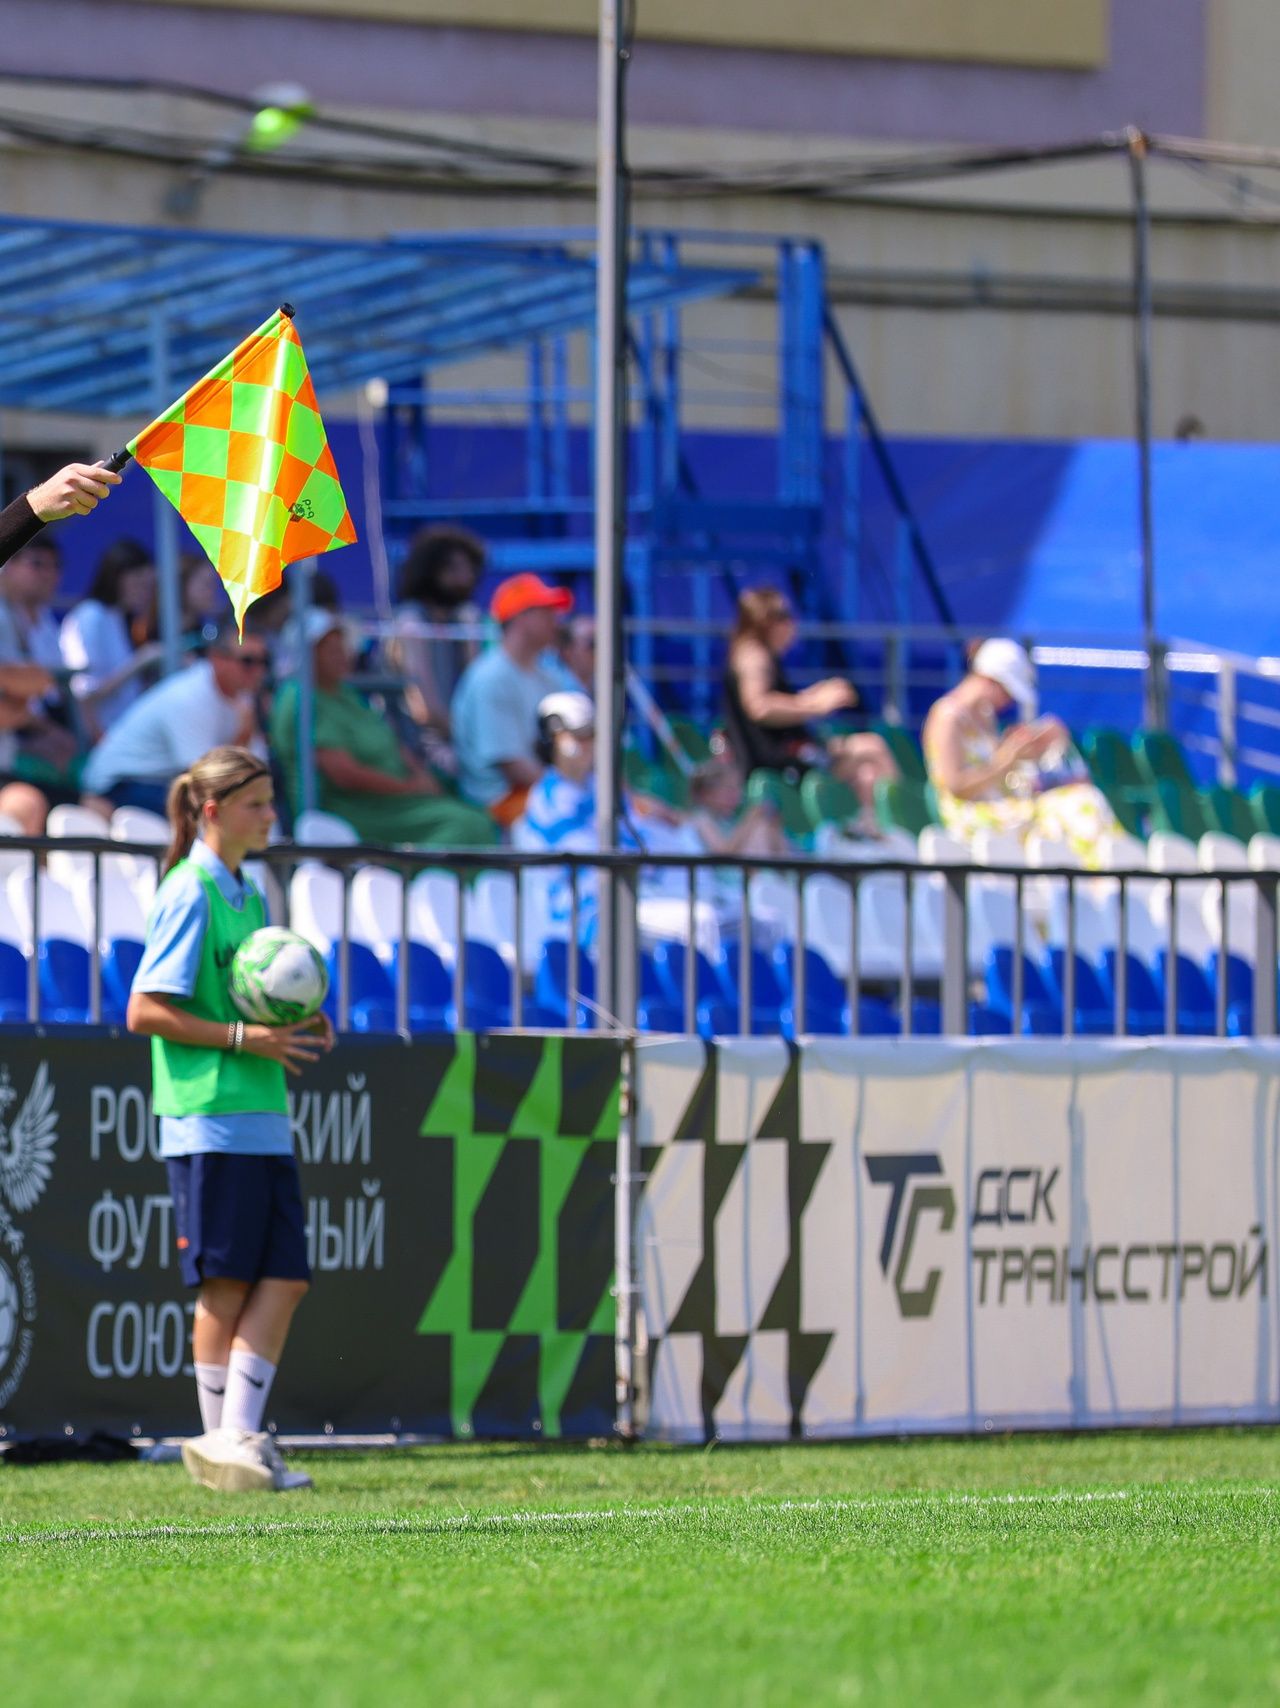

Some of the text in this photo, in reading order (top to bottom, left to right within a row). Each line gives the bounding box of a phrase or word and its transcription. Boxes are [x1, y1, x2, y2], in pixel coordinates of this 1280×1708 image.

[91, 1071, 371, 1164] РОКИЙ
[88, 1177, 385, 1272] ФУТЫЙ
[972, 1165, 1060, 1229] ДСК
[971, 1222, 1269, 1307] ТРАНССТРОЙ
